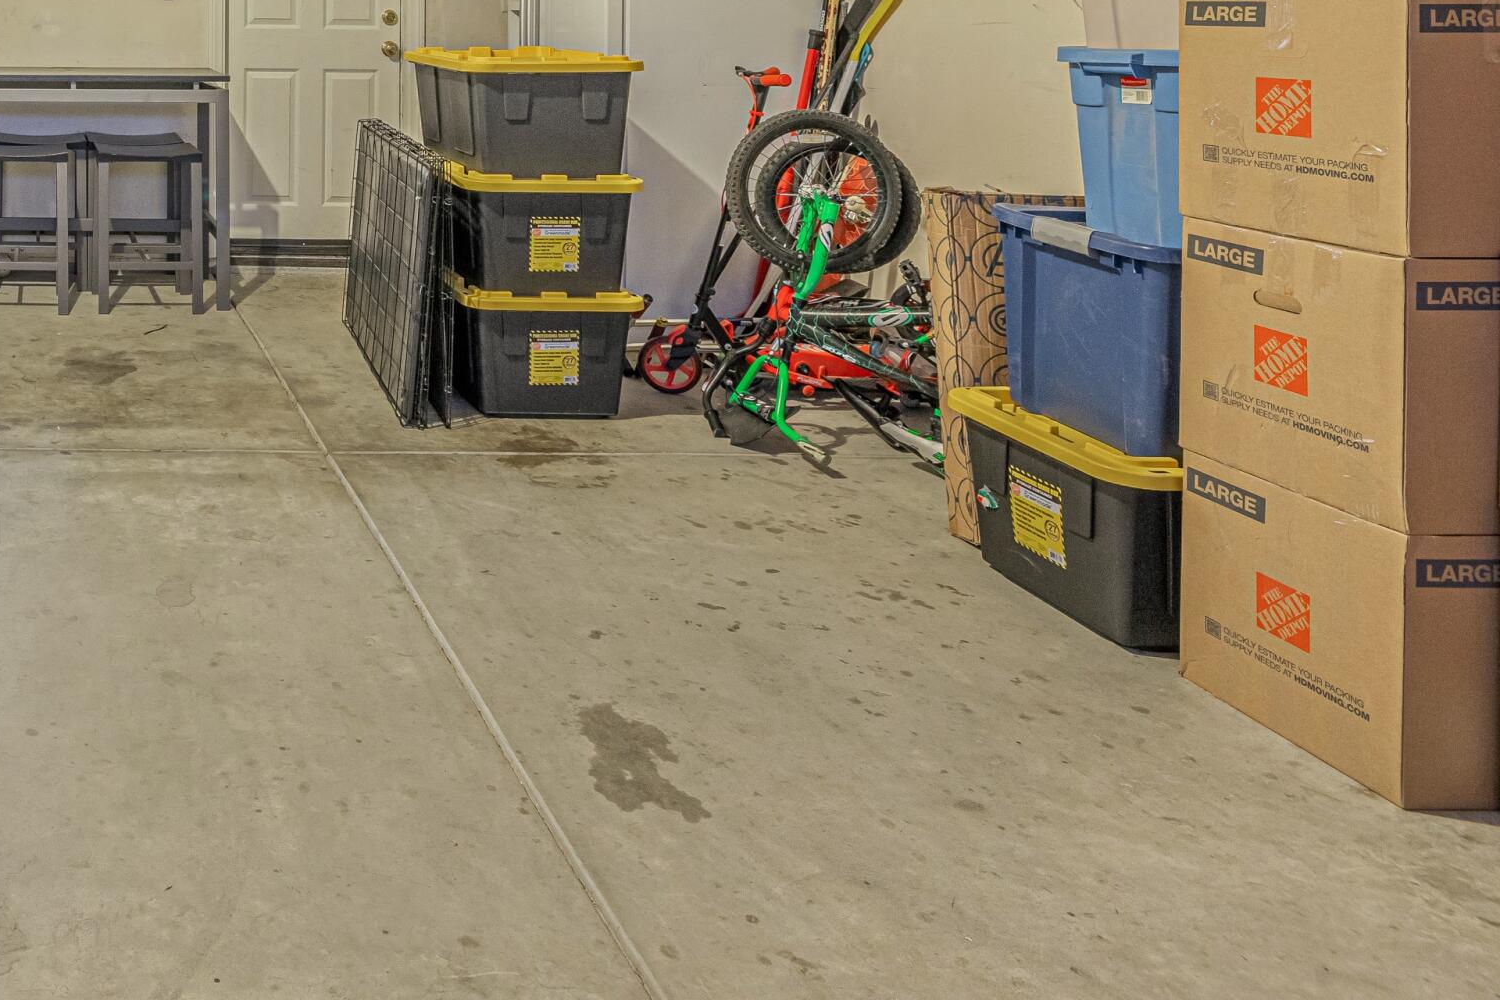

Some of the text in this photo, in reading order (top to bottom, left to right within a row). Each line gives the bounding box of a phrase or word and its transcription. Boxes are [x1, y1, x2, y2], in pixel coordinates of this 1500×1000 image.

[1193, 6, 1257, 22] LARGE
[1256, 80, 1311, 134] HOME
[1262, 85, 1284, 106] THE
[1277, 102, 1311, 135] DEPOT
[1222, 147, 1368, 171] QUICKLY ESTIMATE YOUR PACKING
[1222, 156, 1252, 167] SUPPLY
[1254, 161, 1281, 171] NEEDS
[1296, 166, 1374, 183] HDMOVING.COM
[1195, 240, 1255, 268] LARGE
[1254, 336, 1307, 383] HOME
[1260, 336, 1280, 355] THE
[1275, 361, 1307, 388] DEPOT
[1222, 387, 1363, 440] QUICKLY ESTIMATE YOUR PACKING
[1222, 396, 1369, 453] SUPPLY NEEDS AT HDMOVING.COM
[1194, 474, 1257, 515] LARGE
[1263, 586, 1283, 605] THE
[1258, 590, 1310, 632] HOME
[1278, 616, 1309, 640] DEPOT
[1223, 626, 1364, 709] QUICKLY ESTIMATE YOUR PACKING
[1223, 637, 1370, 722] SUPPLY NEEDS AT HDMOVING.COM
